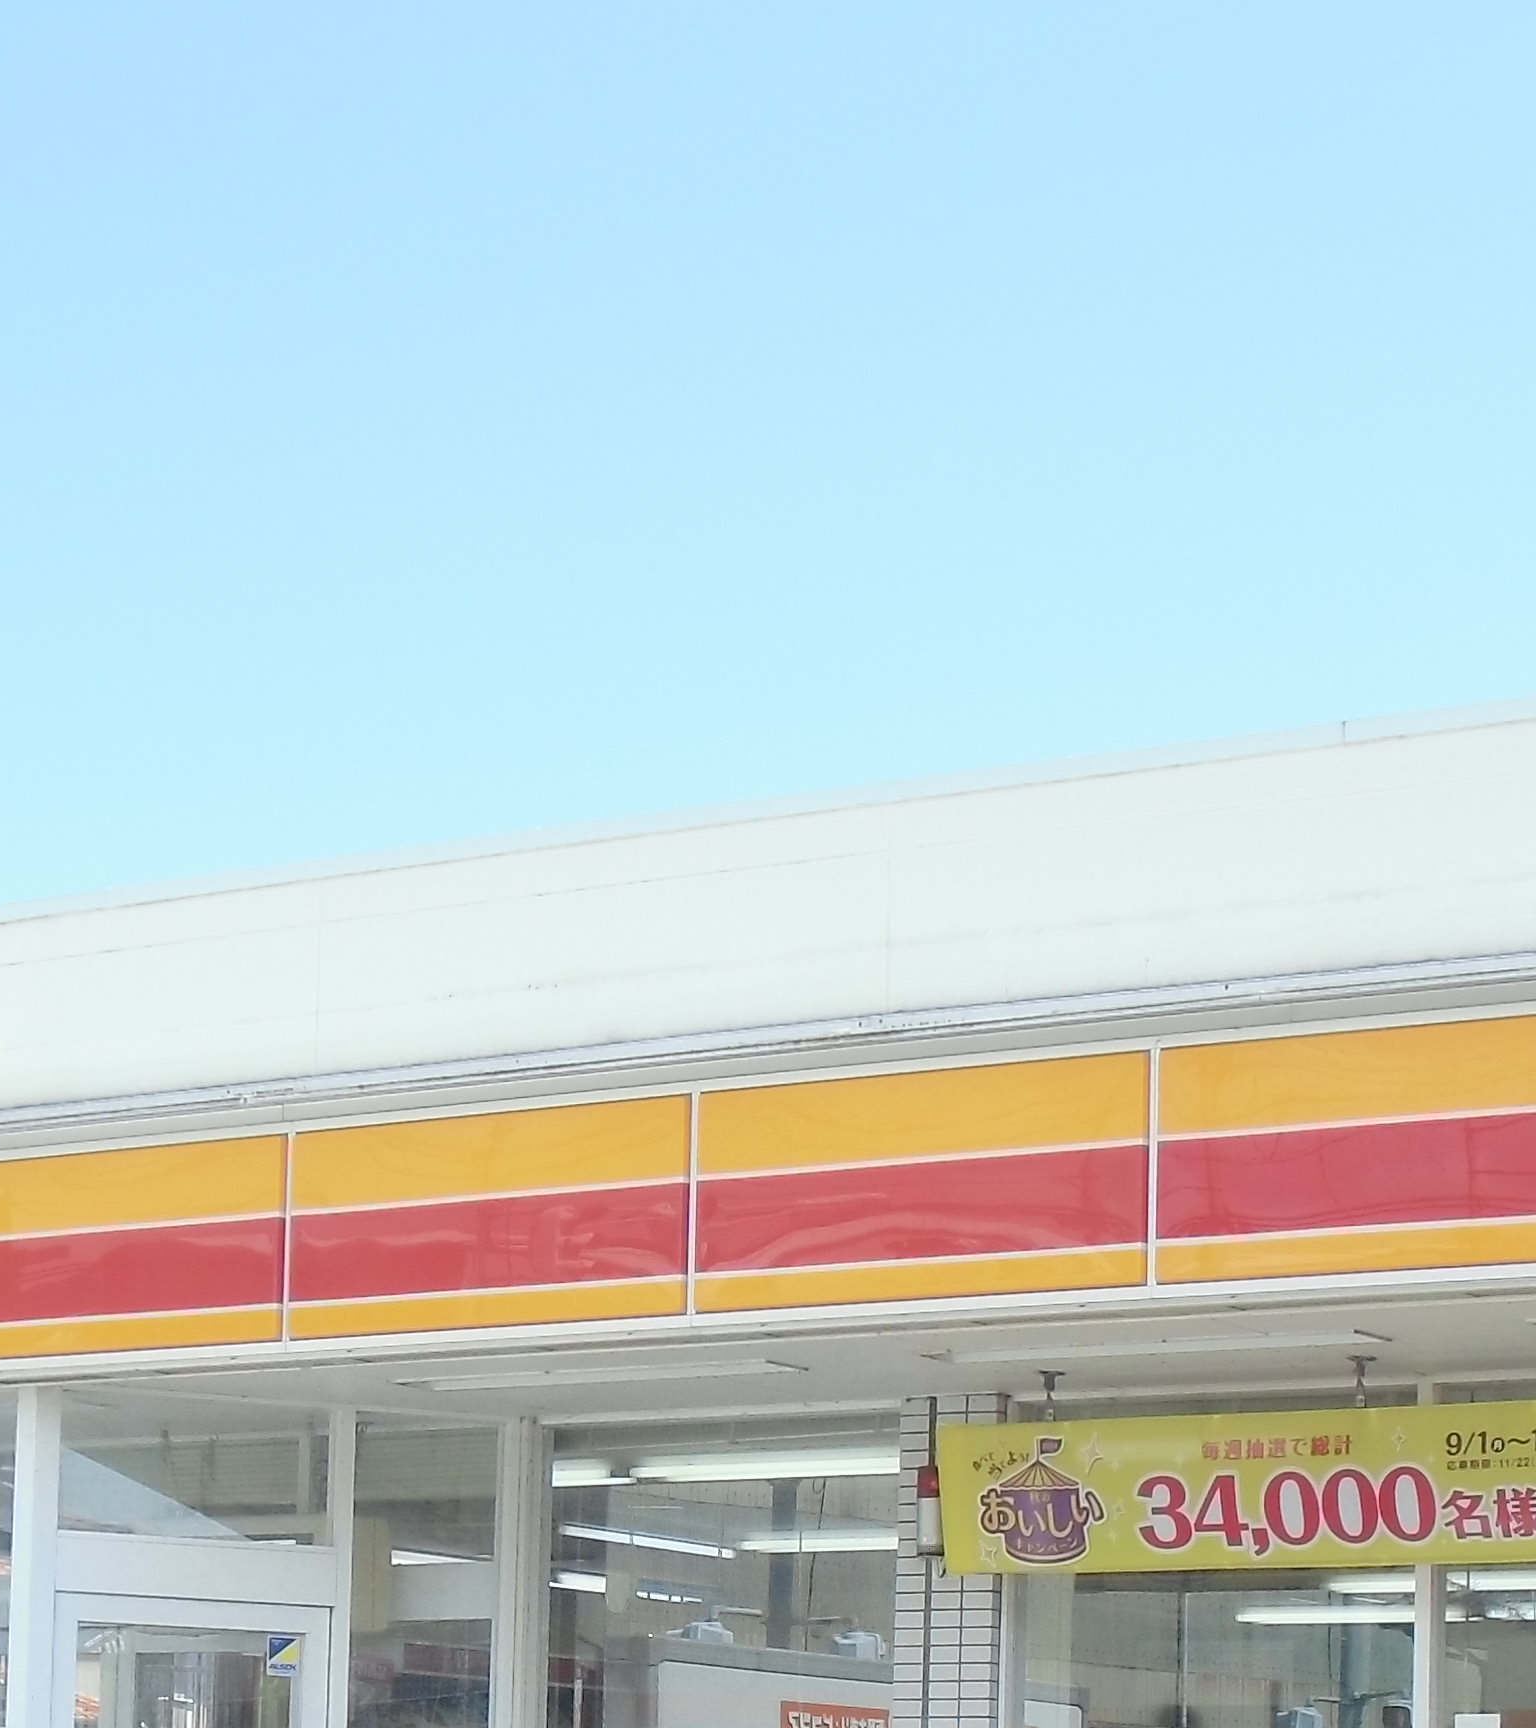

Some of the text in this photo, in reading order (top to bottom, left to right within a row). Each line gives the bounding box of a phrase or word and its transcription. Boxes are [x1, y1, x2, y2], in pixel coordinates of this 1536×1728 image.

[1201, 1434, 1353, 1460] 毎週抽選で総計
[980, 1488, 1104, 1538] おいしい
